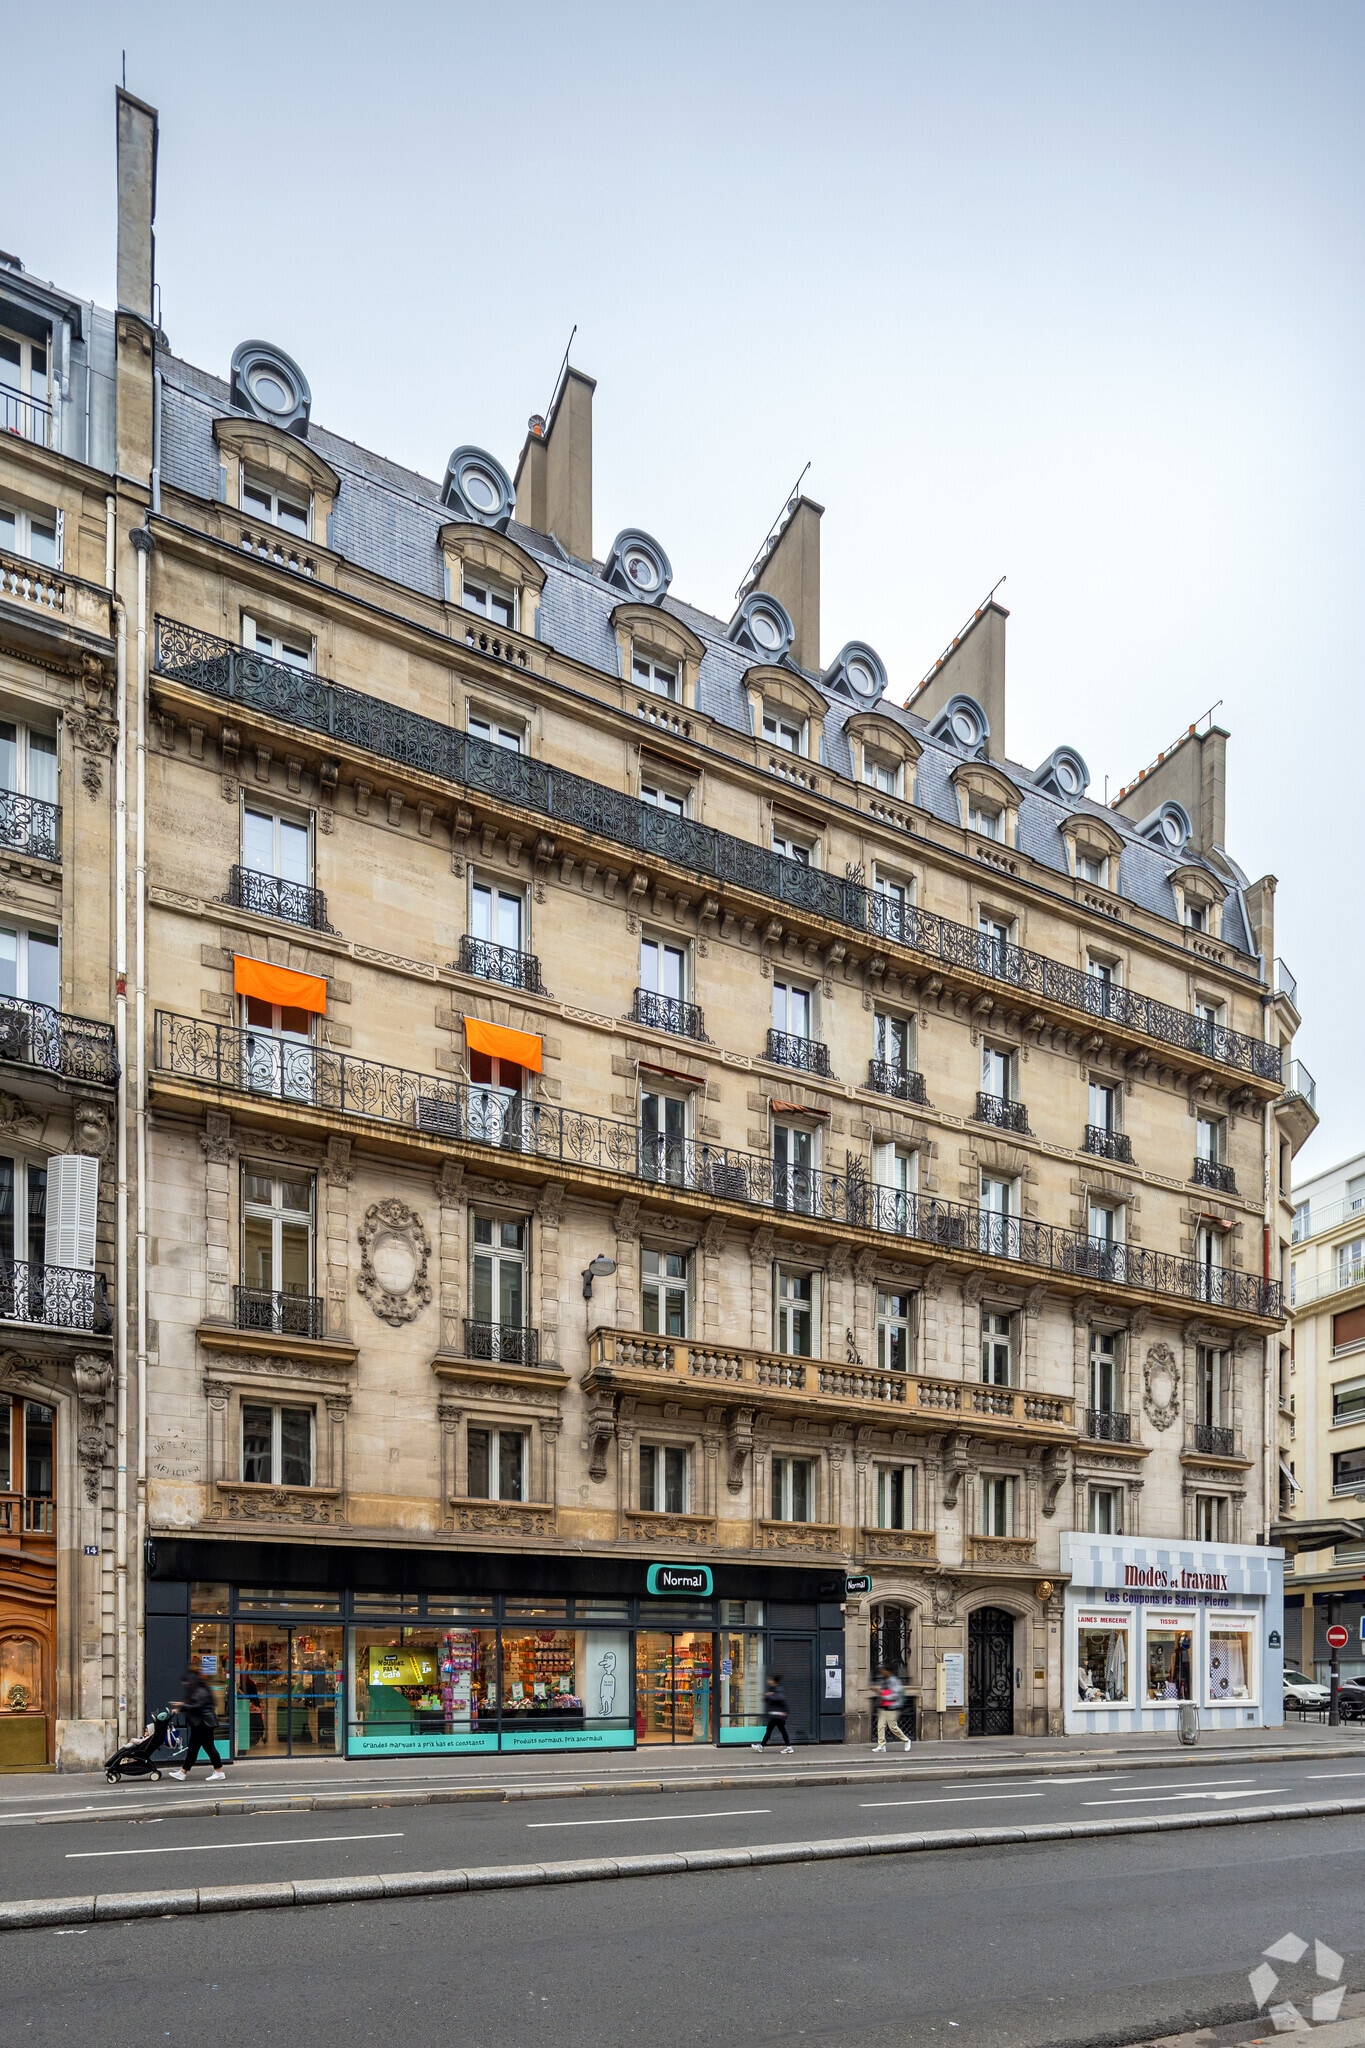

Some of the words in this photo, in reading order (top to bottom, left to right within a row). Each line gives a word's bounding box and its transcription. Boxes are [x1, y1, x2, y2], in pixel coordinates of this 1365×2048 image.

[85, 1546, 97, 1554] 14
[663, 1571, 702, 1587] Normal
[847, 1579, 866, 1590] Normal
[1124, 1565, 1168, 1588] Modes
[1170, 1579, 1178, 1588] et
[1180, 1568, 1228, 1591] travaux
[1104, 1592, 1120, 1603] Les
[1122, 1592, 1160, 1605] Coupons
[1162, 1594, 1173, 1604] de
[1175, 1594, 1197, 1606] Saint
[1204, 1595, 1229, 1607] Pierre
